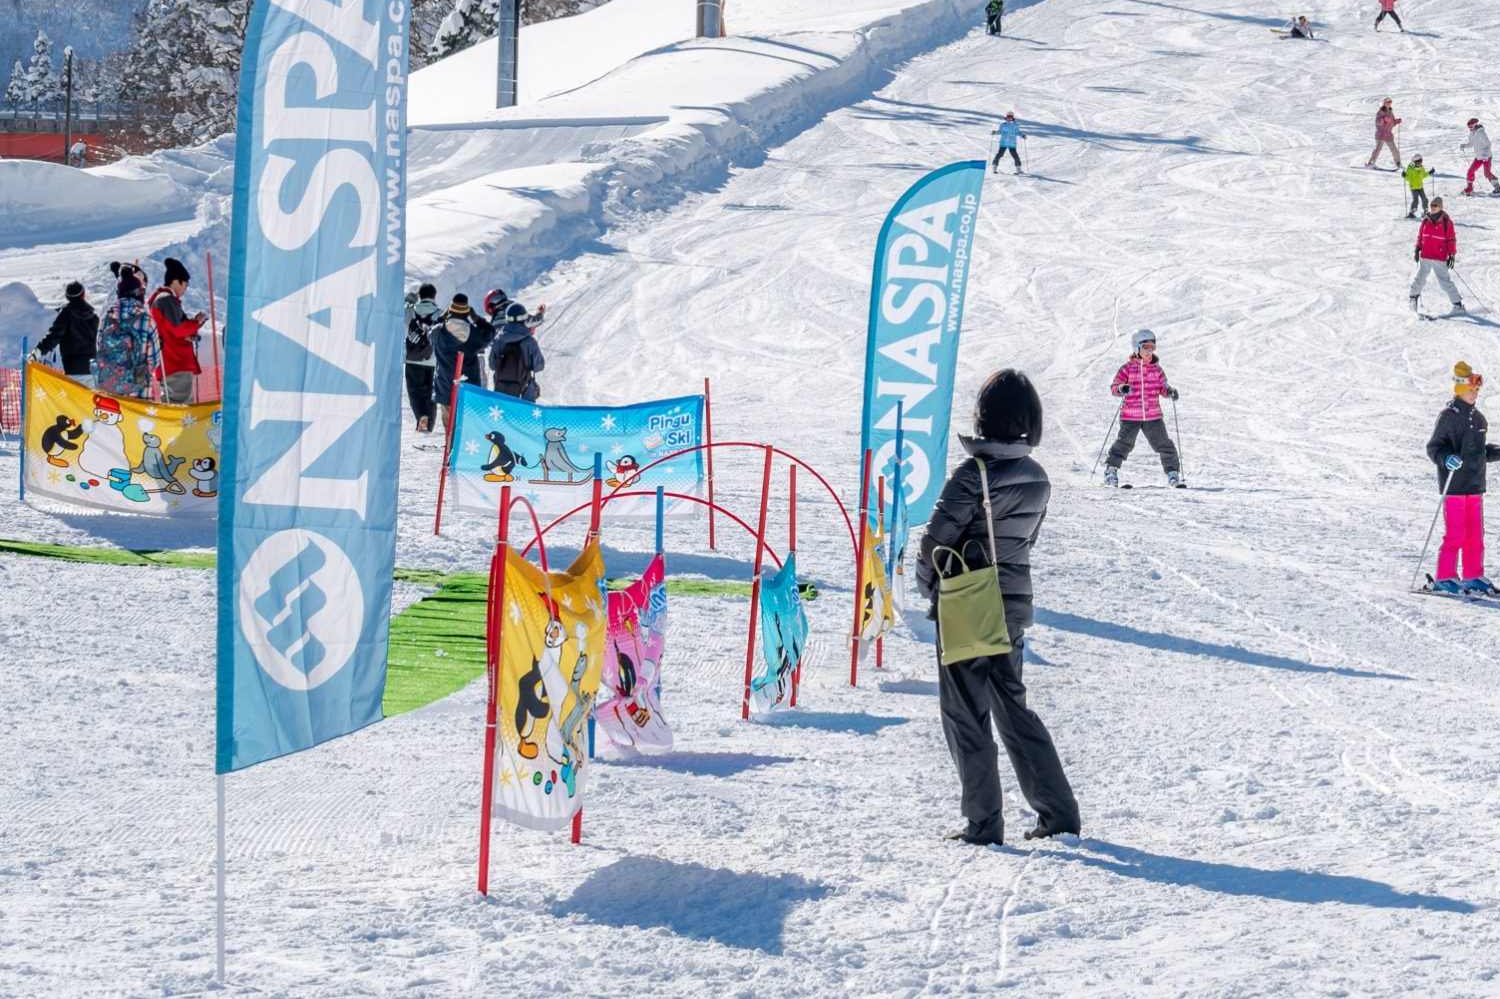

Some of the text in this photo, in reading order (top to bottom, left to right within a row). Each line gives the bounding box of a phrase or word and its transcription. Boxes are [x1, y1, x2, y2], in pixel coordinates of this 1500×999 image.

[946, 193, 977, 333] www.naspa.co.jp
[874, 194, 961, 436] NASPA
[650, 414, 690, 430] Pingu
[667, 430, 690, 445] Ski
